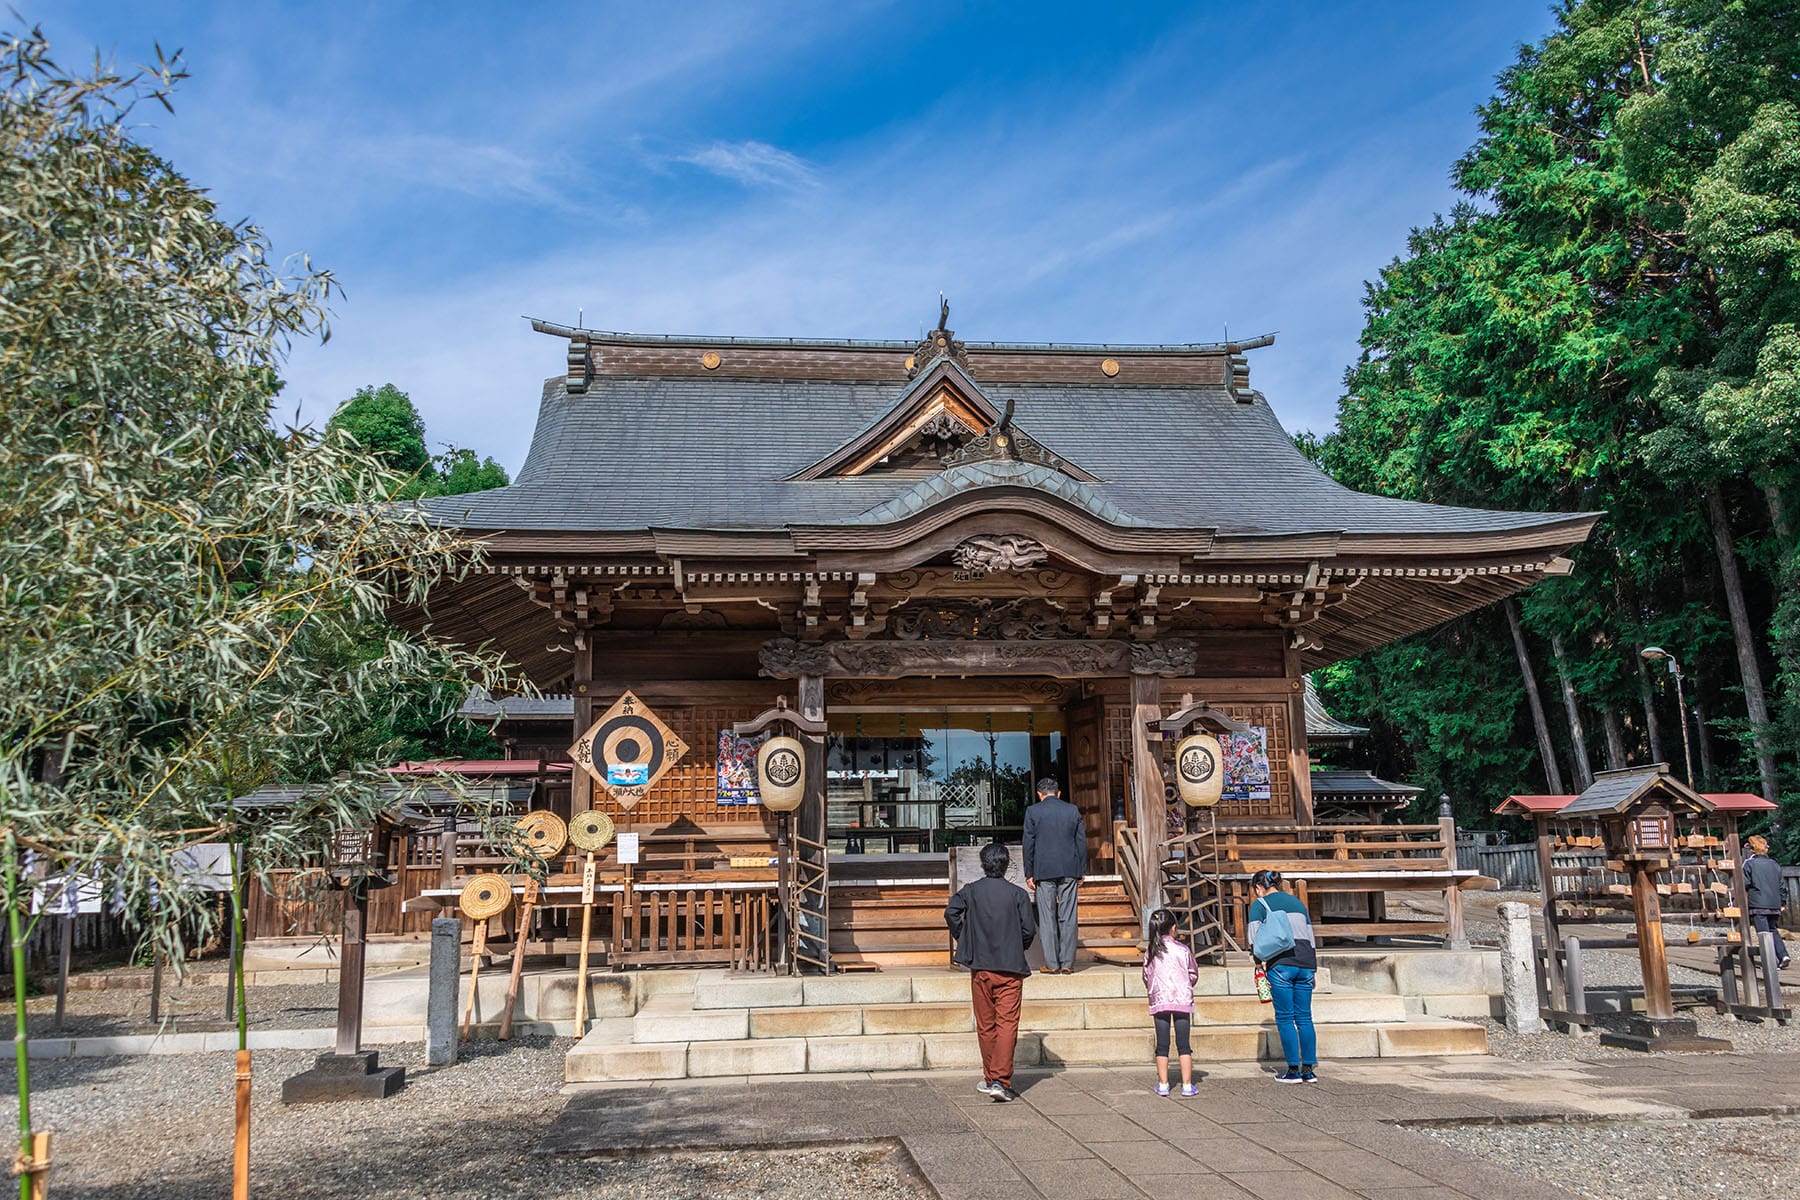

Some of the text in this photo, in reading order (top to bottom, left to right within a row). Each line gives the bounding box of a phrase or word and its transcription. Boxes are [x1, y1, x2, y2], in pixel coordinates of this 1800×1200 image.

[622, 695, 635, 715] 奉納
[577, 738, 592, 764] 成就
[665, 738, 680, 761] 心願
